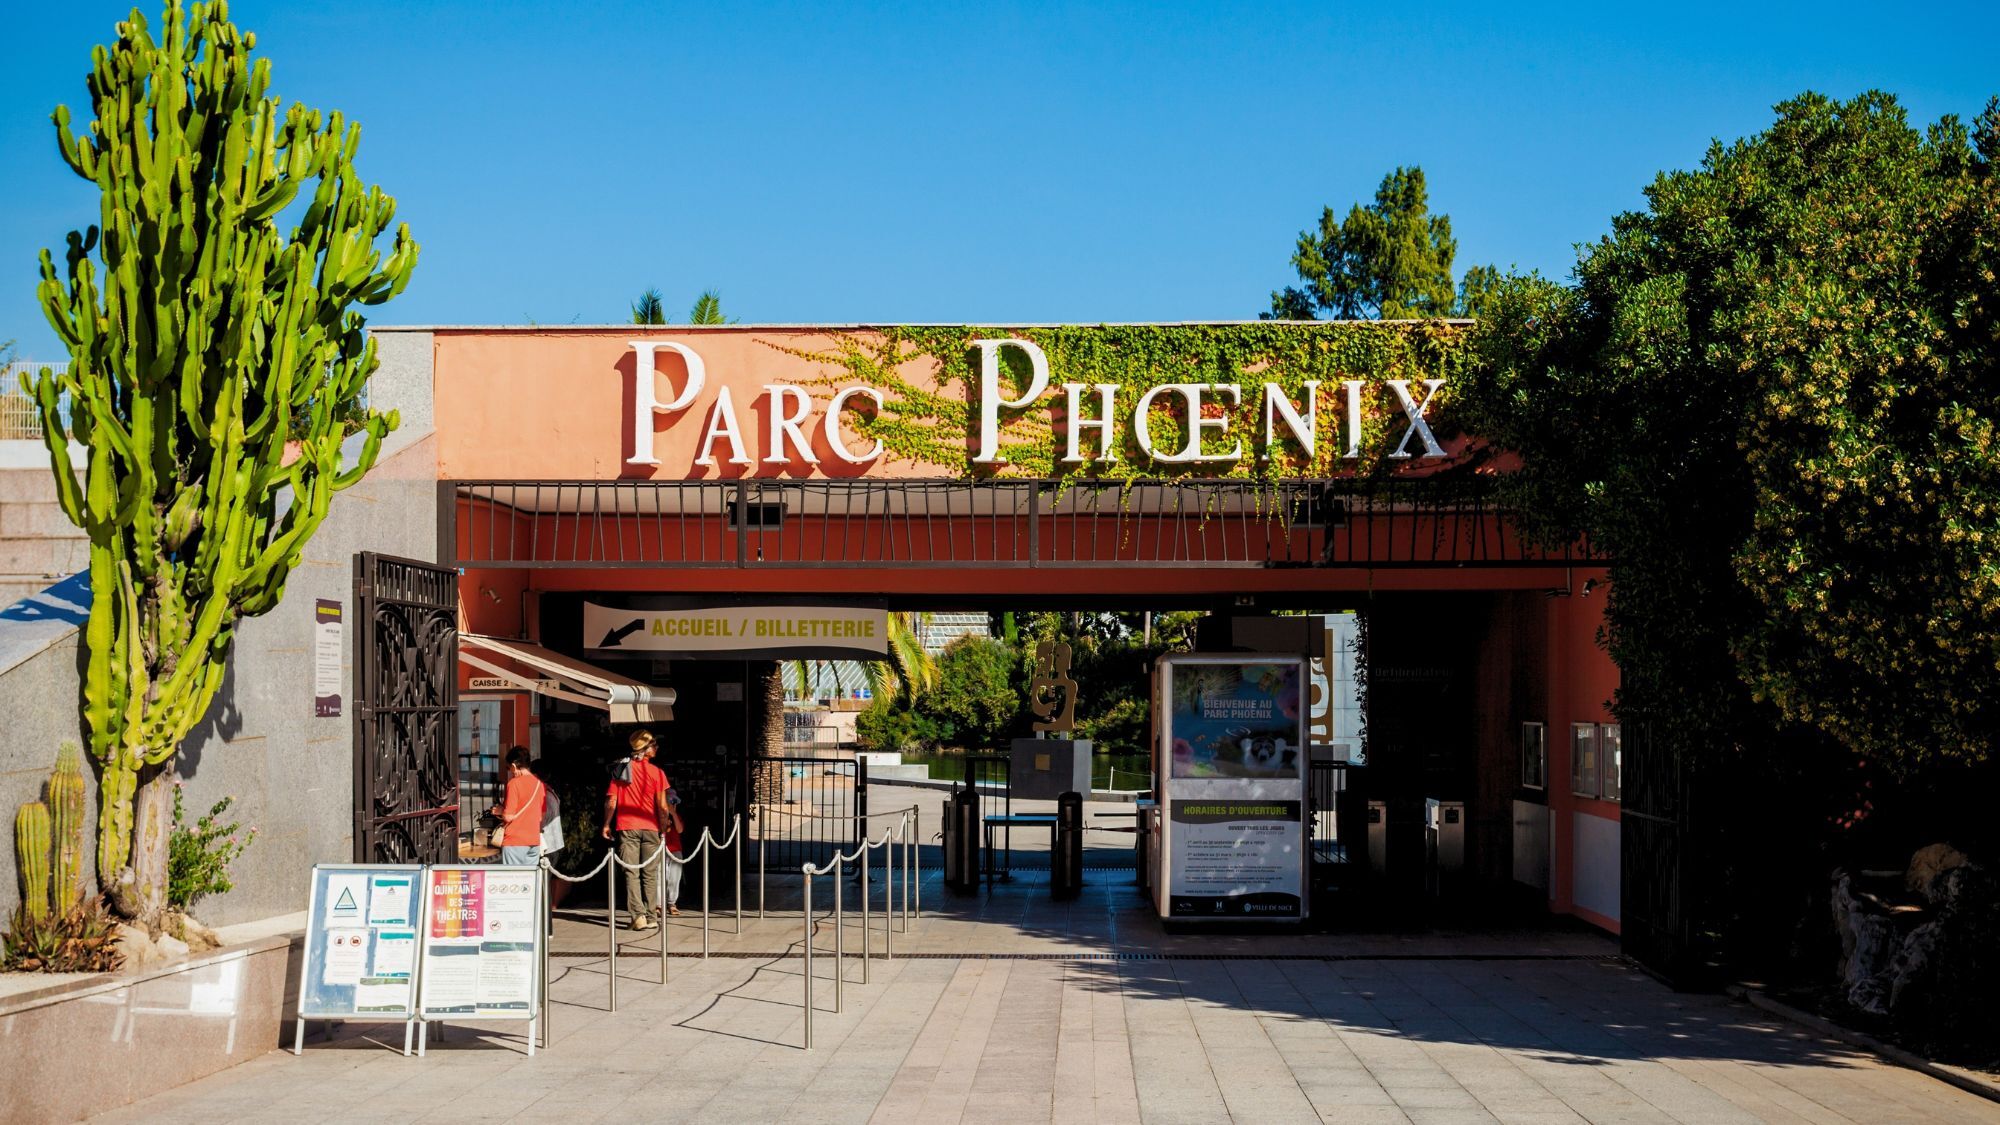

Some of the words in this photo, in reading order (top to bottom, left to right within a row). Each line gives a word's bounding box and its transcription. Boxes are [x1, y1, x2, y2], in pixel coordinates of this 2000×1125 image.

[626, 339, 884, 466] PARC
[651, 618, 732, 637] ACCUEIL
[739, 619, 748, 637] /
[755, 619, 875, 638] BILLETTERIE
[472, 679, 501, 687] CAISSE
[503, 679, 509, 687] 2
[1203, 699, 1257, 709] BIENVENUE
[1259, 699, 1273, 709] AU
[1203, 709, 1229, 719] PARC
[1231, 709, 1273, 719] PHOENIX
[1183, 806, 1226, 815] HORAIRES
[1229, 806, 1287, 815] D'OUVERTURE
[434, 884, 477, 895] QUINZAINE
[449, 898, 463, 907] DES
